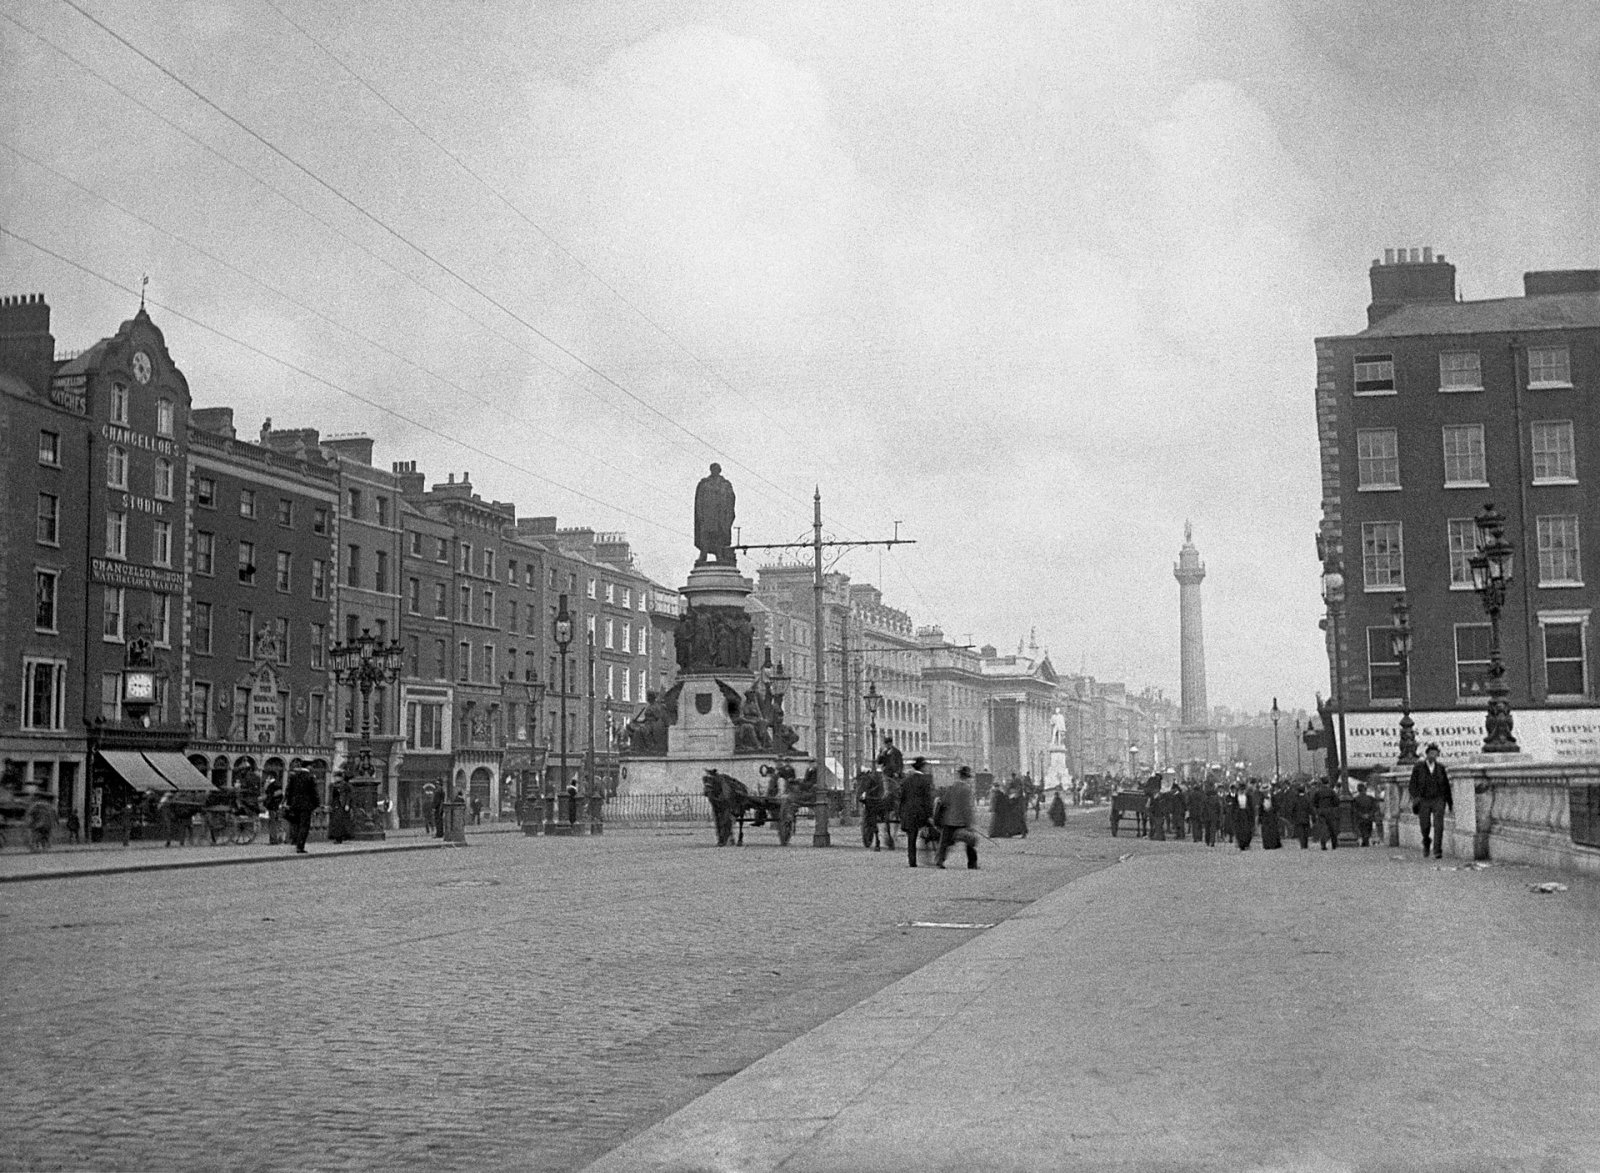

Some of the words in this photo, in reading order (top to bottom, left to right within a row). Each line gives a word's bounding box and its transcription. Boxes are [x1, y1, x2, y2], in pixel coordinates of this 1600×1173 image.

[122, 494, 163, 515] STUDIO
[92, 559, 156, 580] CHANCELLOR
[93, 569, 121, 583] WATCH
[254, 706, 276, 715] HALL
[1349, 727, 1419, 737] HOPKIS
[1422, 727, 1432, 736] &
[1435, 726, 1484, 736] HOPKI
